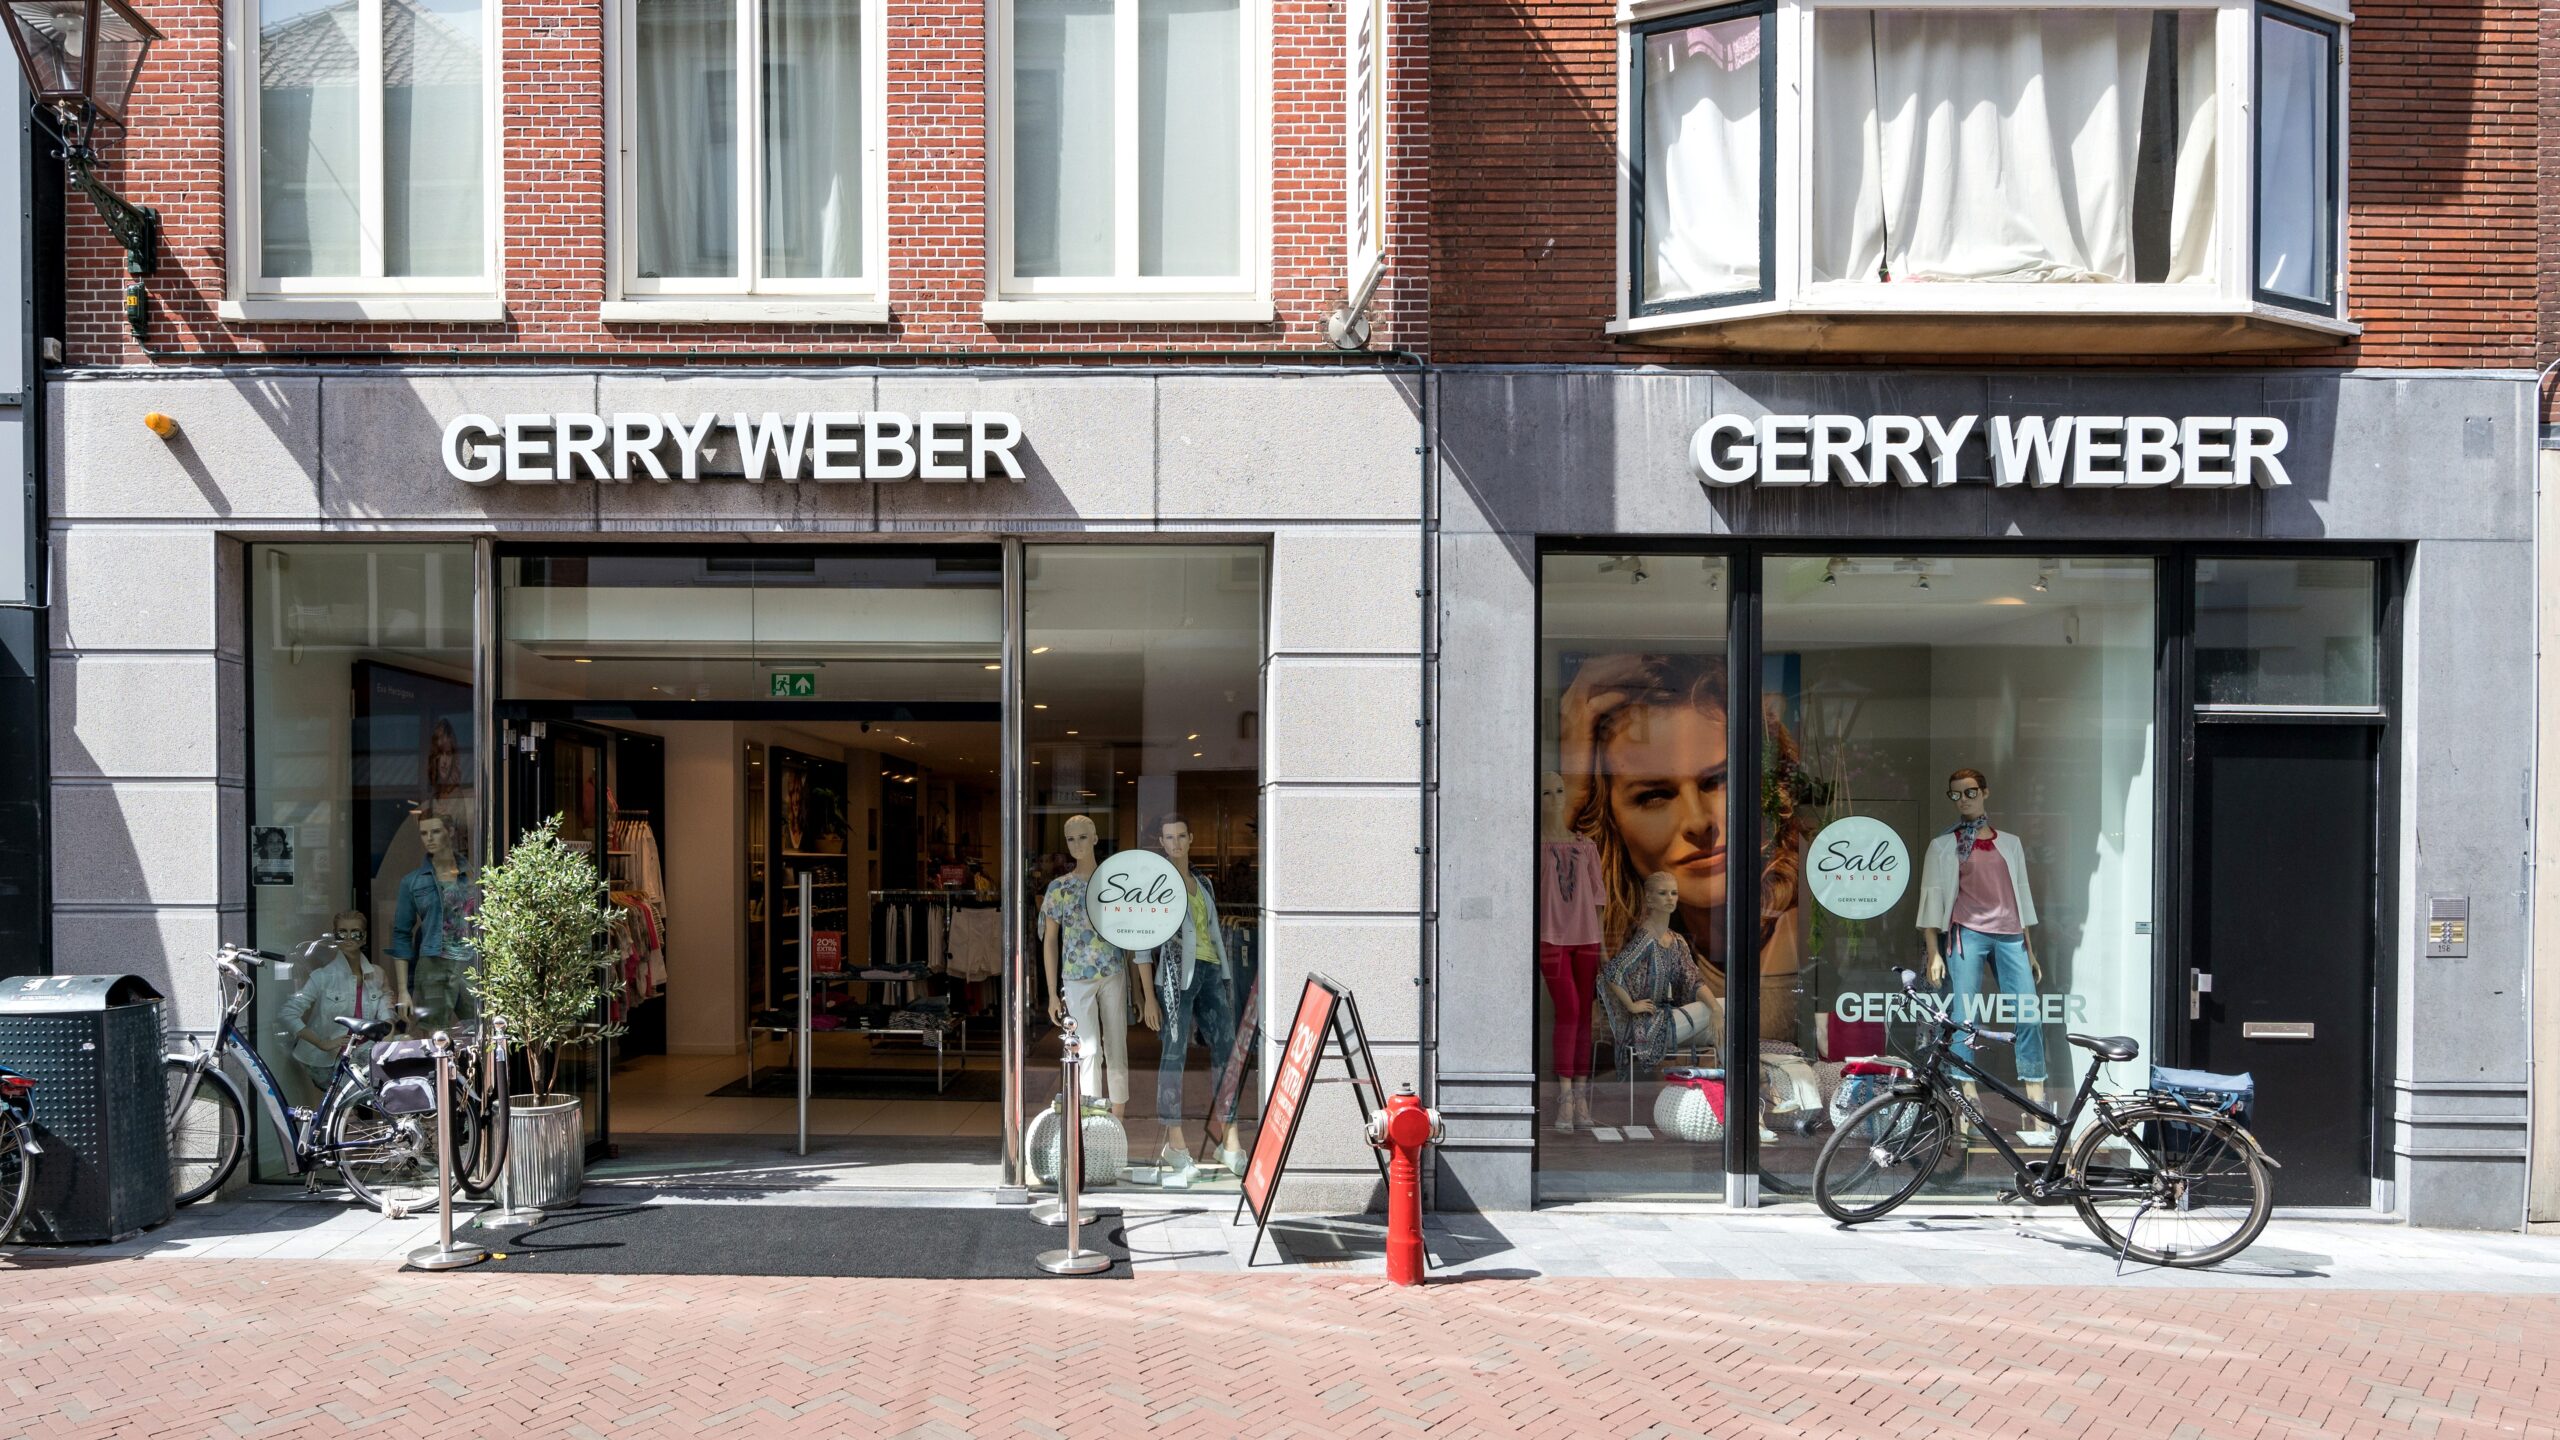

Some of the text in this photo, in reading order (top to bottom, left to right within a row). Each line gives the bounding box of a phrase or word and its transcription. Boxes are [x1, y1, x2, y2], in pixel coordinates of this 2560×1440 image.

[441, 411, 1026, 486] GERRY WEBER
[1692, 414, 2292, 488] GERRY WEBER
[1818, 840, 1899, 872] Sale
[1098, 873, 1176, 904] Sale
[1104, 906, 1169, 914] INSIDE
[816, 938, 837, 946] 20%
[1836, 992, 2088, 1024] GERRY WEBER
[1290, 1021, 1317, 1072] 20%
[1281, 1060, 1303, 1104] EXTRA
